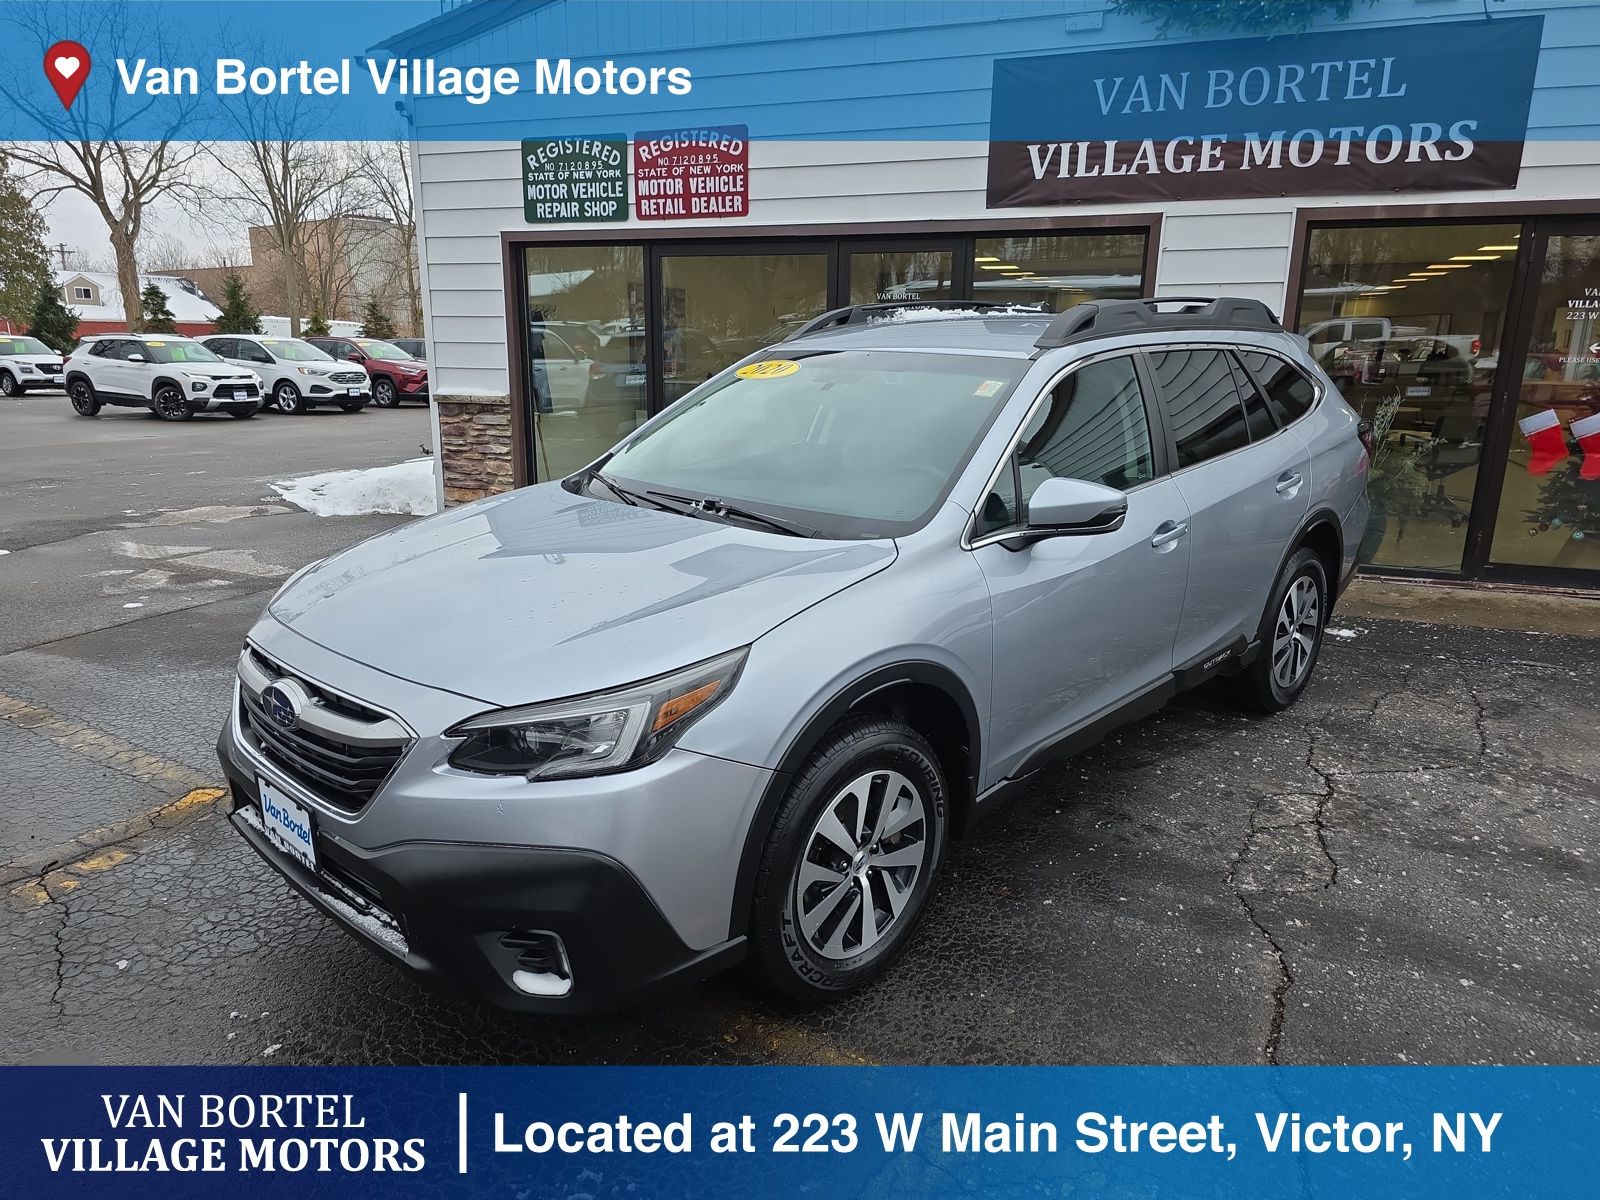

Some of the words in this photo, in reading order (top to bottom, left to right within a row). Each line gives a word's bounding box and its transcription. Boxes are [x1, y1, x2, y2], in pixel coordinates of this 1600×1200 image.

[1093, 71, 1191, 116] VAN
[1203, 56, 1407, 110] BORTEL
[638, 128, 744, 163] REGISTERED
[1026, 133, 1228, 180] VILLAGE
[1239, 119, 1479, 171] MOTORS
[526, 138, 622, 171] REGISTERED
[671, 154, 719, 165] 7120895
[559, 160, 603, 171] 7120895
[637, 167, 668, 178] STATE
[672, 166, 685, 176] OF
[689, 165, 711, 175] NEW
[715, 164, 745, 174] YORK
[528, 172, 555, 181] STATE
[557, 171, 570, 181] OF
[572, 170, 593, 180] NEW
[596, 169, 622, 179] YORK
[527, 182, 568, 200] MOTOR
[571, 181, 624, 200] VEHICLE
[638, 177, 684, 197] MOTOR
[689, 174, 745, 195] VEHICLE
[536, 201, 580, 219] REPAIR
[583, 200, 618, 217] SHOP
[641, 198, 687, 216] RETAIL
[691, 195, 743, 214] DEALER
[876, 292, 892, 300] VAN
[893, 292, 921, 300] BORTEL
[1584, 288, 1600, 297] VA
[1567, 300, 1600, 309] VILLA
[1566, 311, 1586, 320] 223
